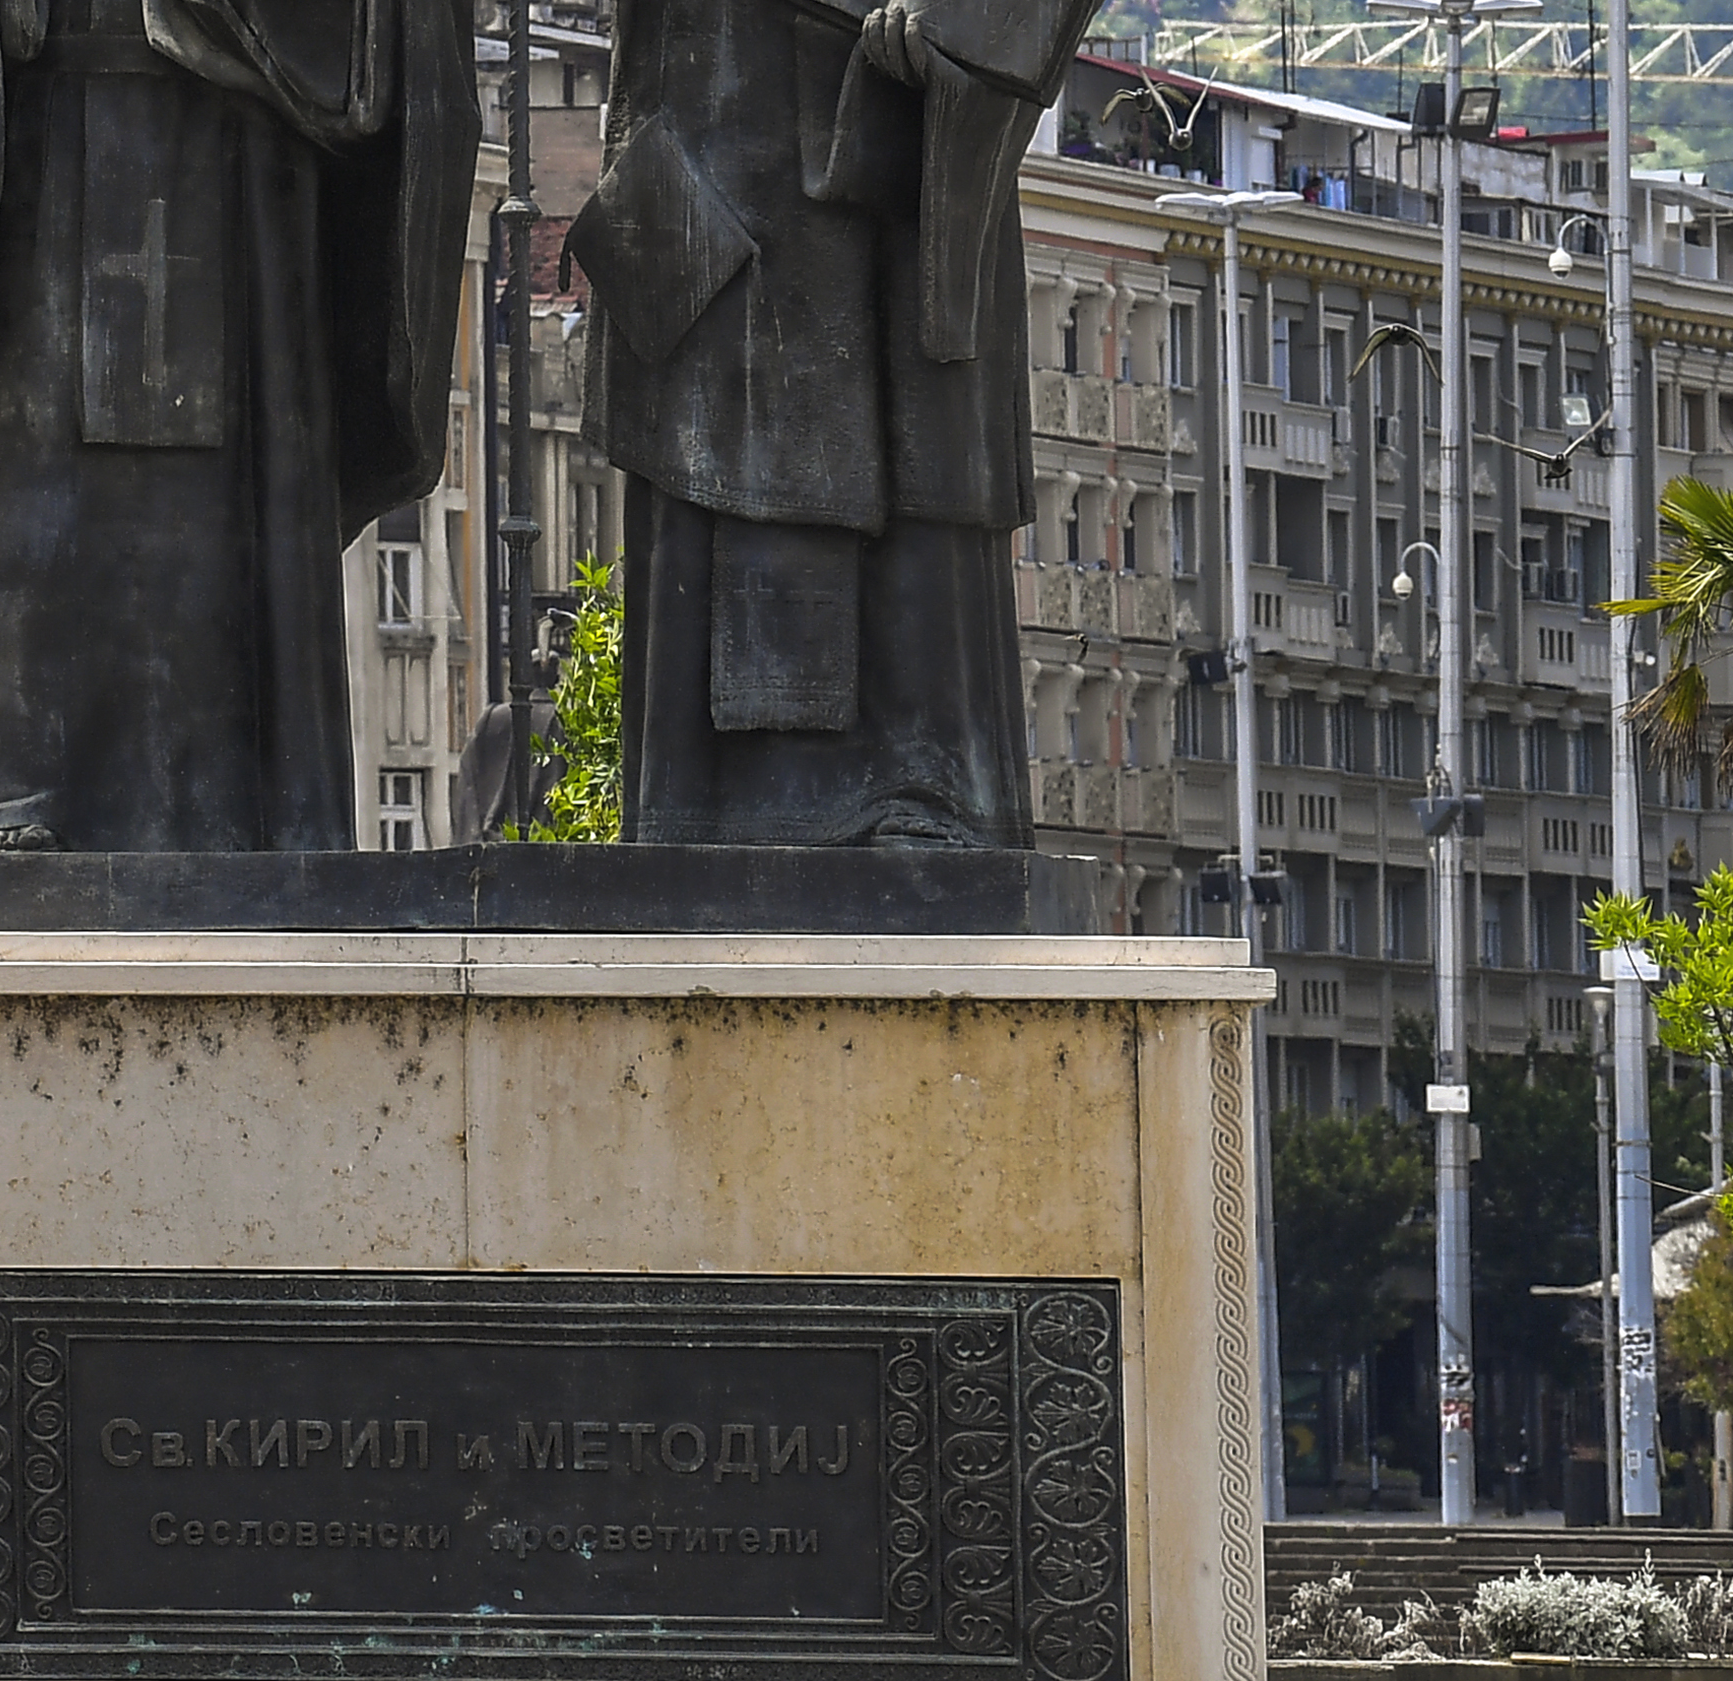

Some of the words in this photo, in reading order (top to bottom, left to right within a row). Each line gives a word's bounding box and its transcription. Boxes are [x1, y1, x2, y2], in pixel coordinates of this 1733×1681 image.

[456, 1433, 491, 1470] и
[517, 1421, 850, 1484] МЕТОДИЈ
[149, 1511, 451, 1548] Сесловенски
[489, 1522, 819, 1559] просветители
